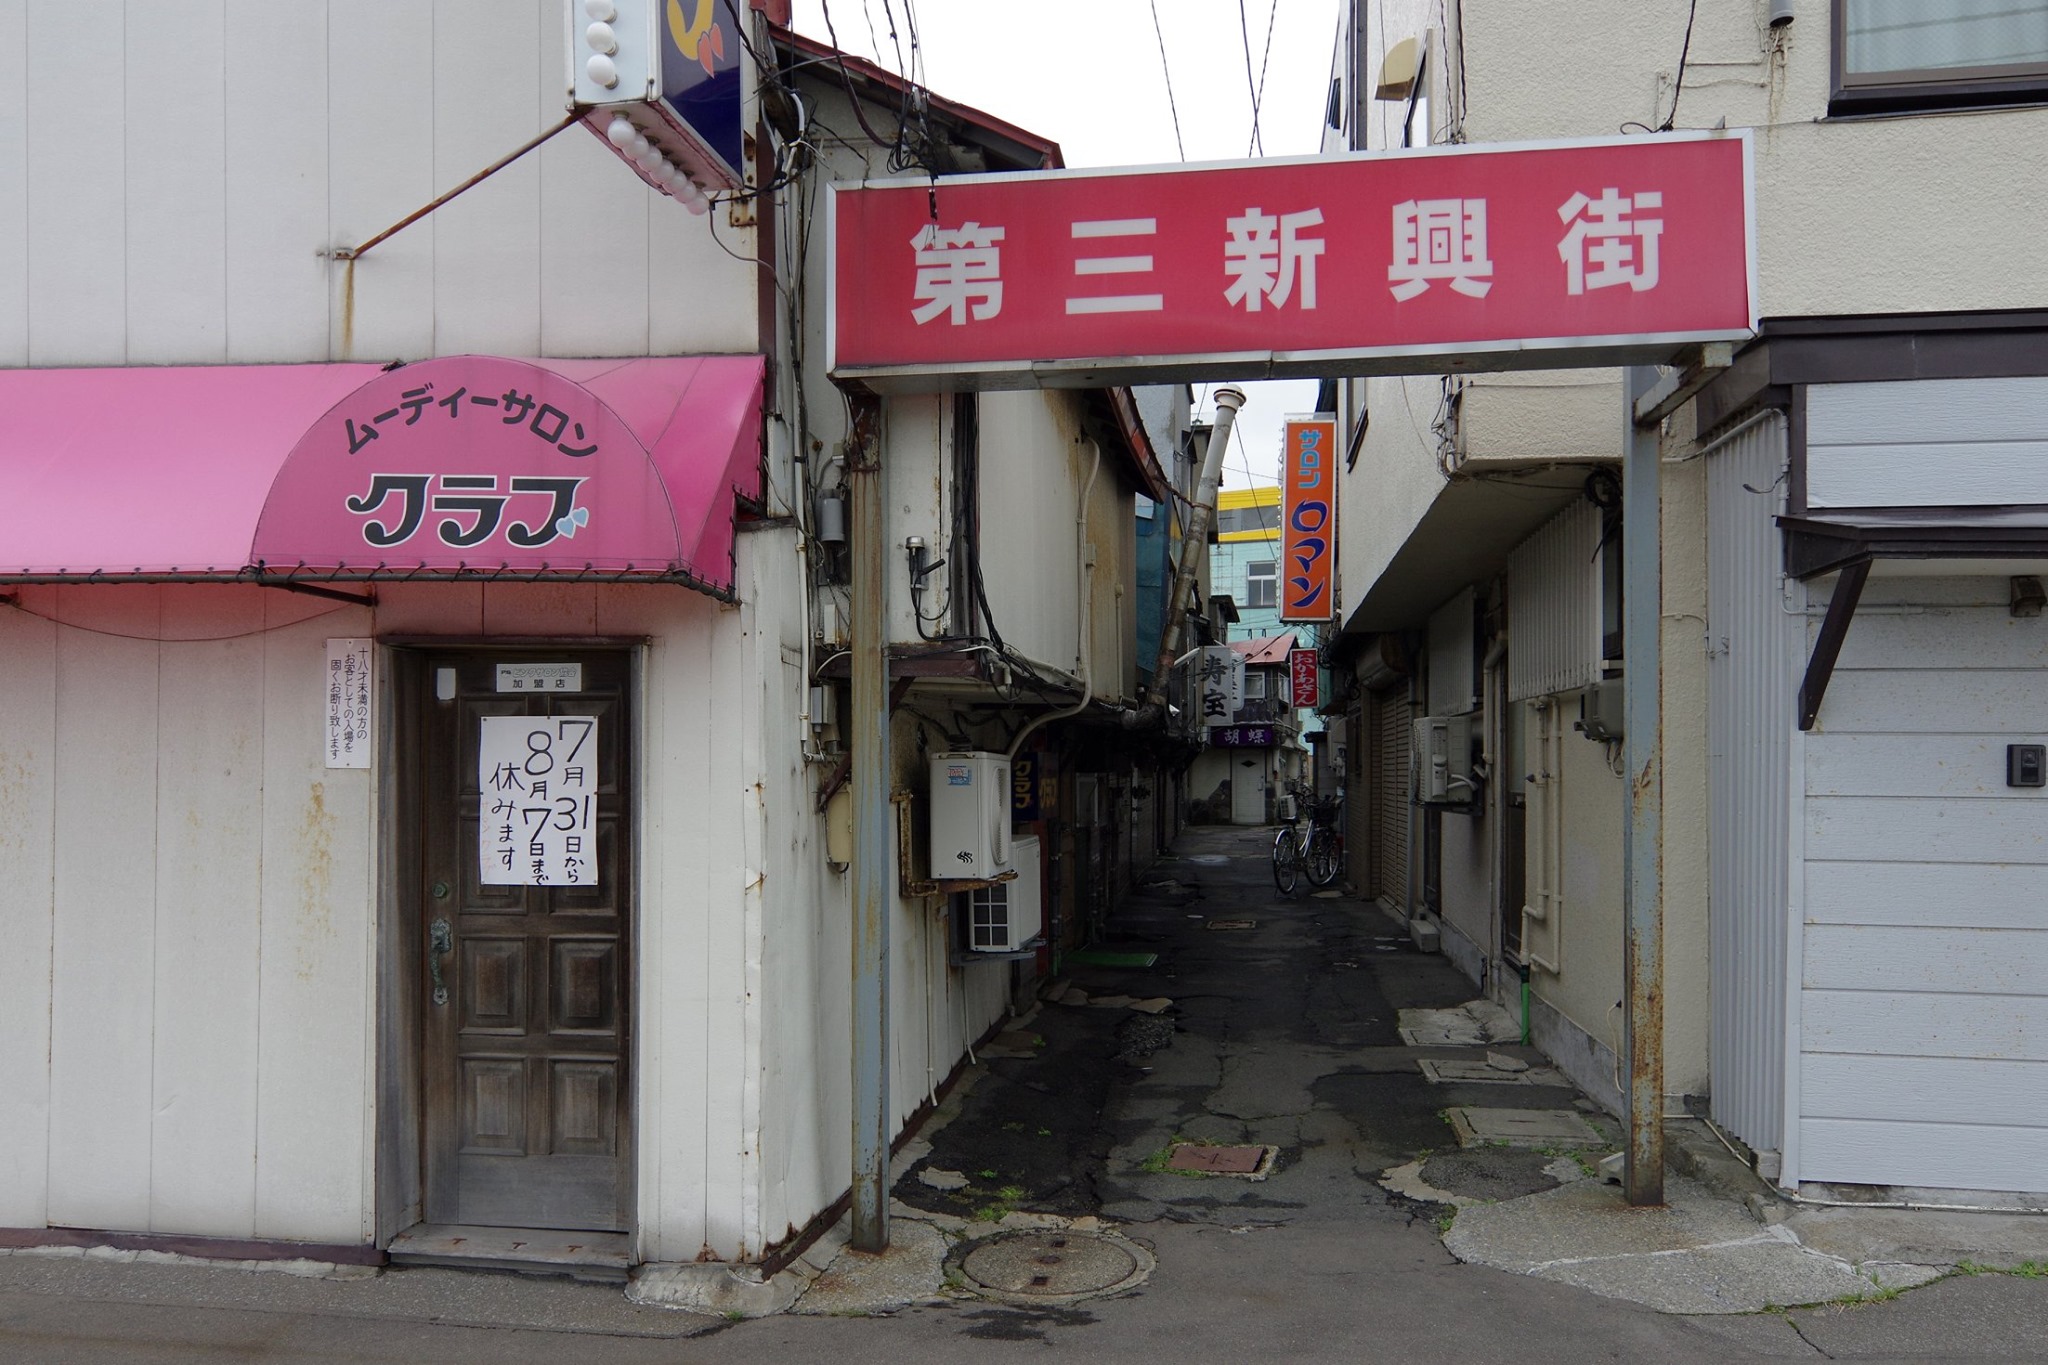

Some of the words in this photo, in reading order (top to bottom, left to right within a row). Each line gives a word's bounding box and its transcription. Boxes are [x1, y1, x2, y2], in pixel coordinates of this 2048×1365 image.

[910, 187, 1665, 326] 第三新興街
[345, 383, 599, 459] ムーディーサロン
[1298, 428, 1323, 489] サロン
[1290, 498, 1329, 608] ロマン
[329, 660, 342, 760] 固くお断り致します
[343, 654, 356, 753] お客としての入場を
[357, 647, 369, 740] 十八才未満の方の
[512, 679, 565, 689] 加盟店
[1199, 654, 1228, 717] 寿宝
[1294, 652, 1316, 705] おかあさん
[489, 762, 525, 871] 休みます
[522, 730, 554, 885] 8月7日まで
[553, 720, 594, 884] 7月31日から
